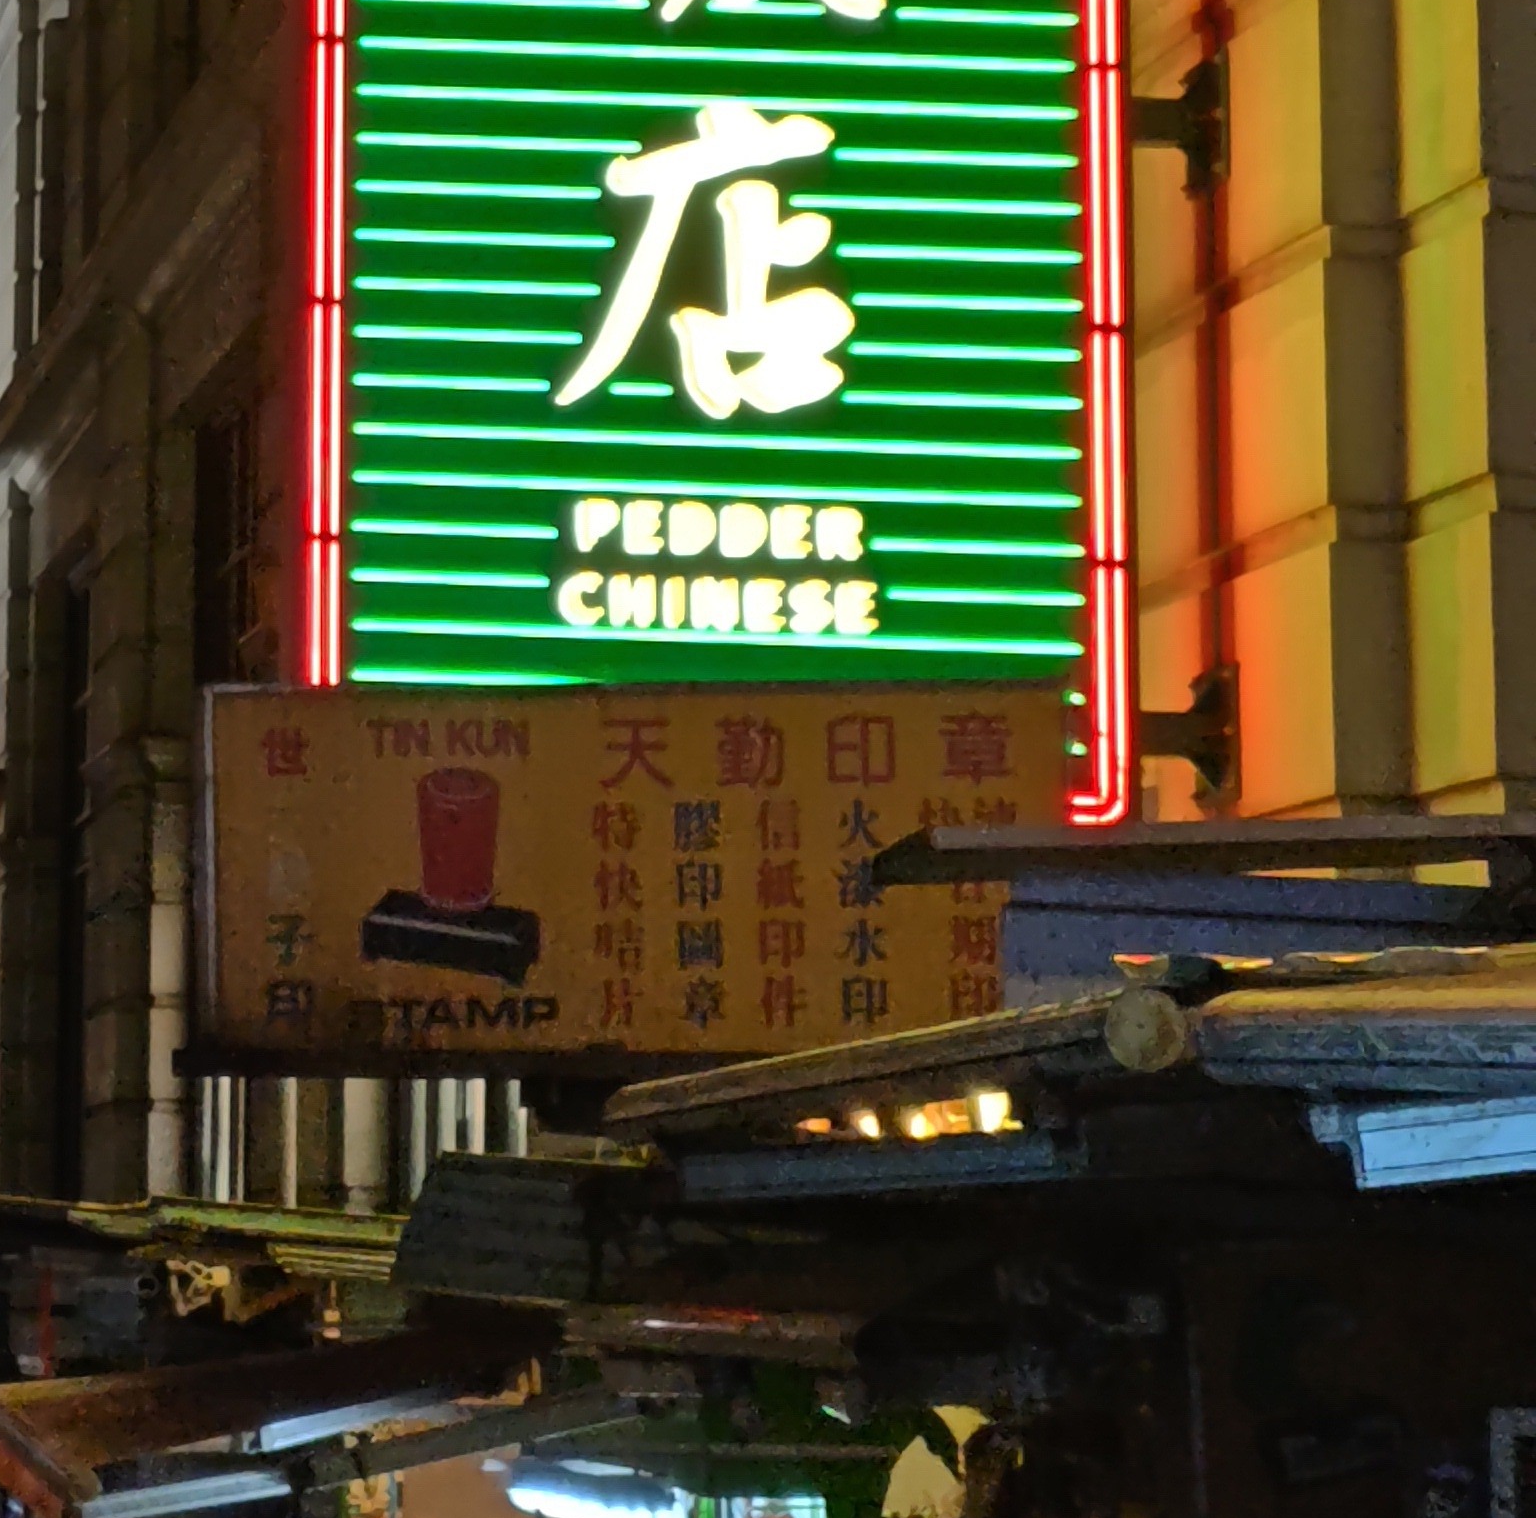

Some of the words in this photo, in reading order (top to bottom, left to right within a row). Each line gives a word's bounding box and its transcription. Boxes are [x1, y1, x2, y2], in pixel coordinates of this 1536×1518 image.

[574, 497, 865, 561] PEDDER
[558, 569, 880, 636] CHINESE
[367, 719, 432, 759] TIN
[446, 718, 532, 759] KUN
[600, 711, 1017, 789] 天勤印章
[672, 798, 726, 1029] 膠印圖章
[755, 798, 809, 1029] 信紙印件
